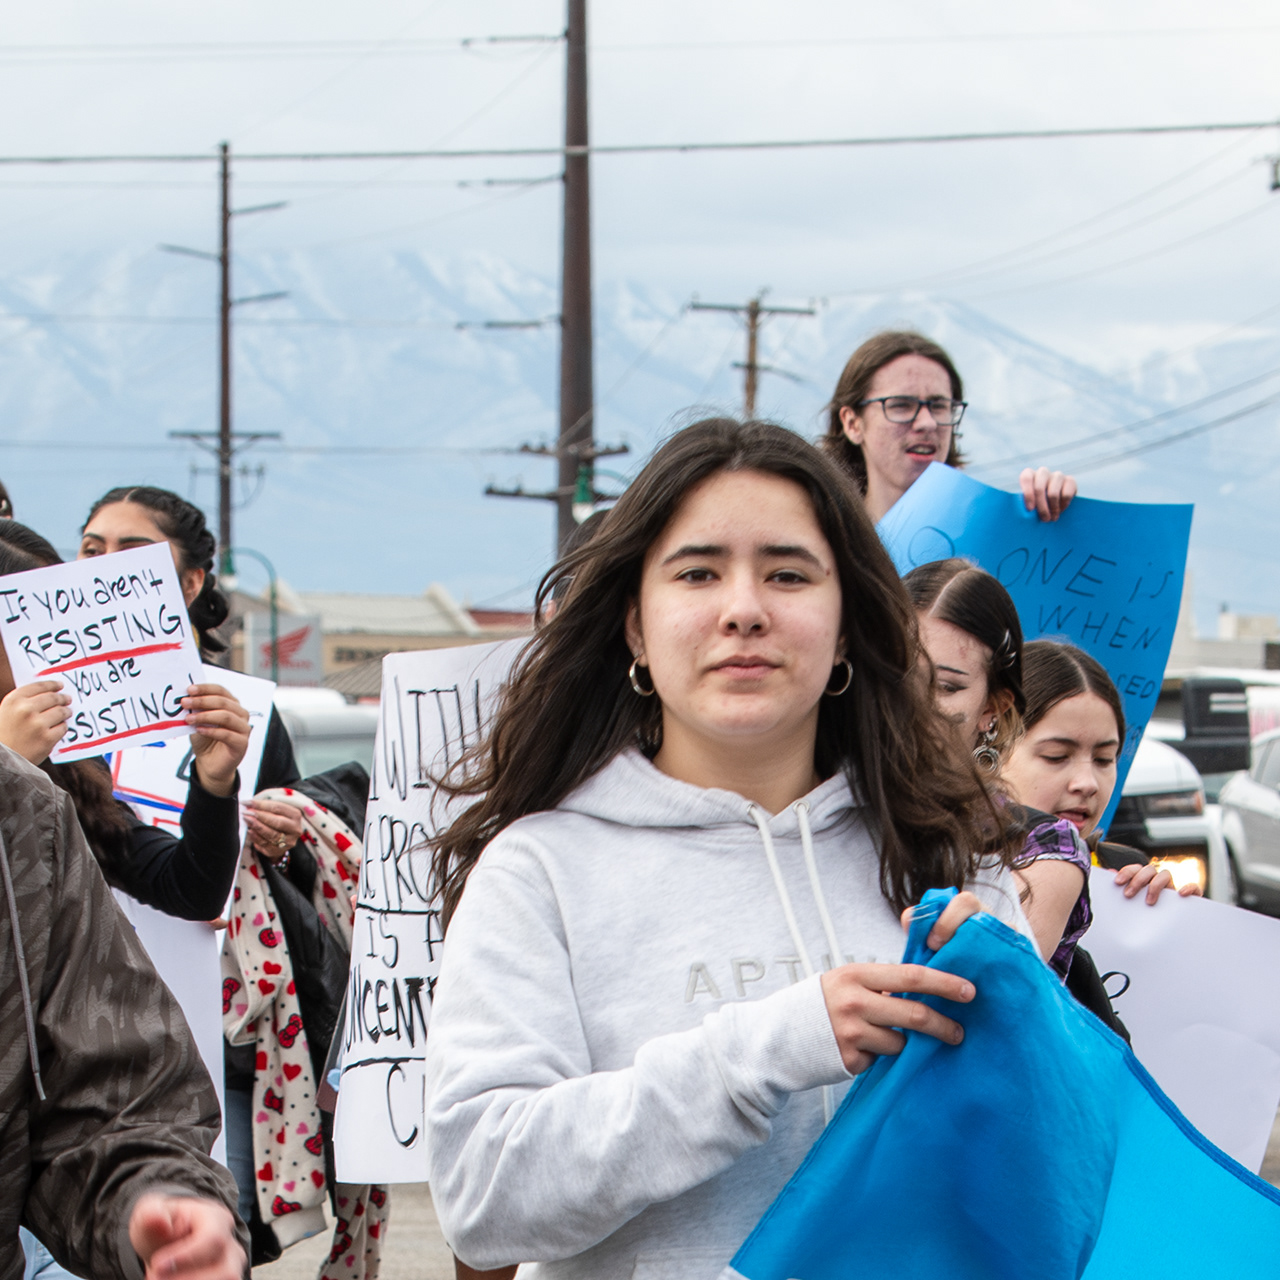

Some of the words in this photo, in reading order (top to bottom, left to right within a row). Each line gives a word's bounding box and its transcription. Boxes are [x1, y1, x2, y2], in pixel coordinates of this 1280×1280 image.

[93, 568, 164, 606] aren't
[997, 547, 1118, 598] ONE
[17, 603, 186, 670] RESISTING
[1037, 604, 1162, 651] WHEN
[108, 656, 141, 684] are
[60, 672, 195, 744] SSISTING
[366, 914, 399, 969] IS
[386, 1062, 426, 1151] C
